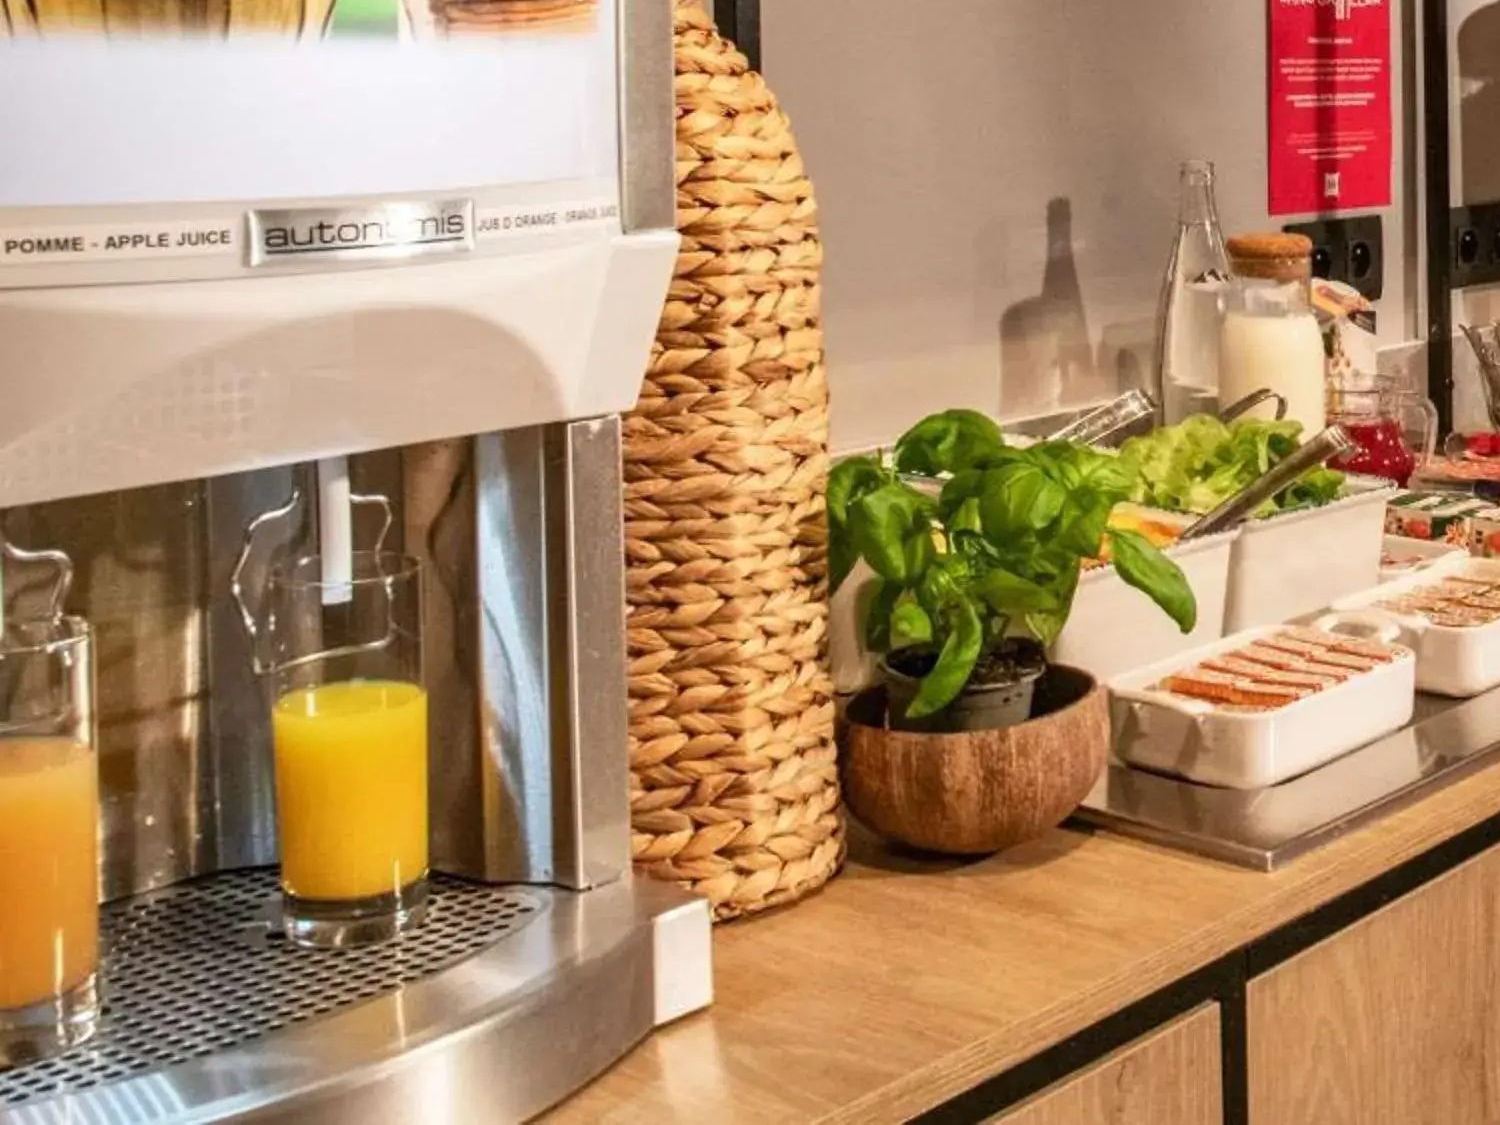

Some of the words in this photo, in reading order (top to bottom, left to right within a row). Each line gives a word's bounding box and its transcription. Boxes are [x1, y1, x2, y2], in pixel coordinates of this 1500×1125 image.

[4, 236, 85, 255] POMME
[104, 232, 170, 250] APPLE
[175, 229, 232, 247] JUICE
[264, 211, 465, 249] autonmis
